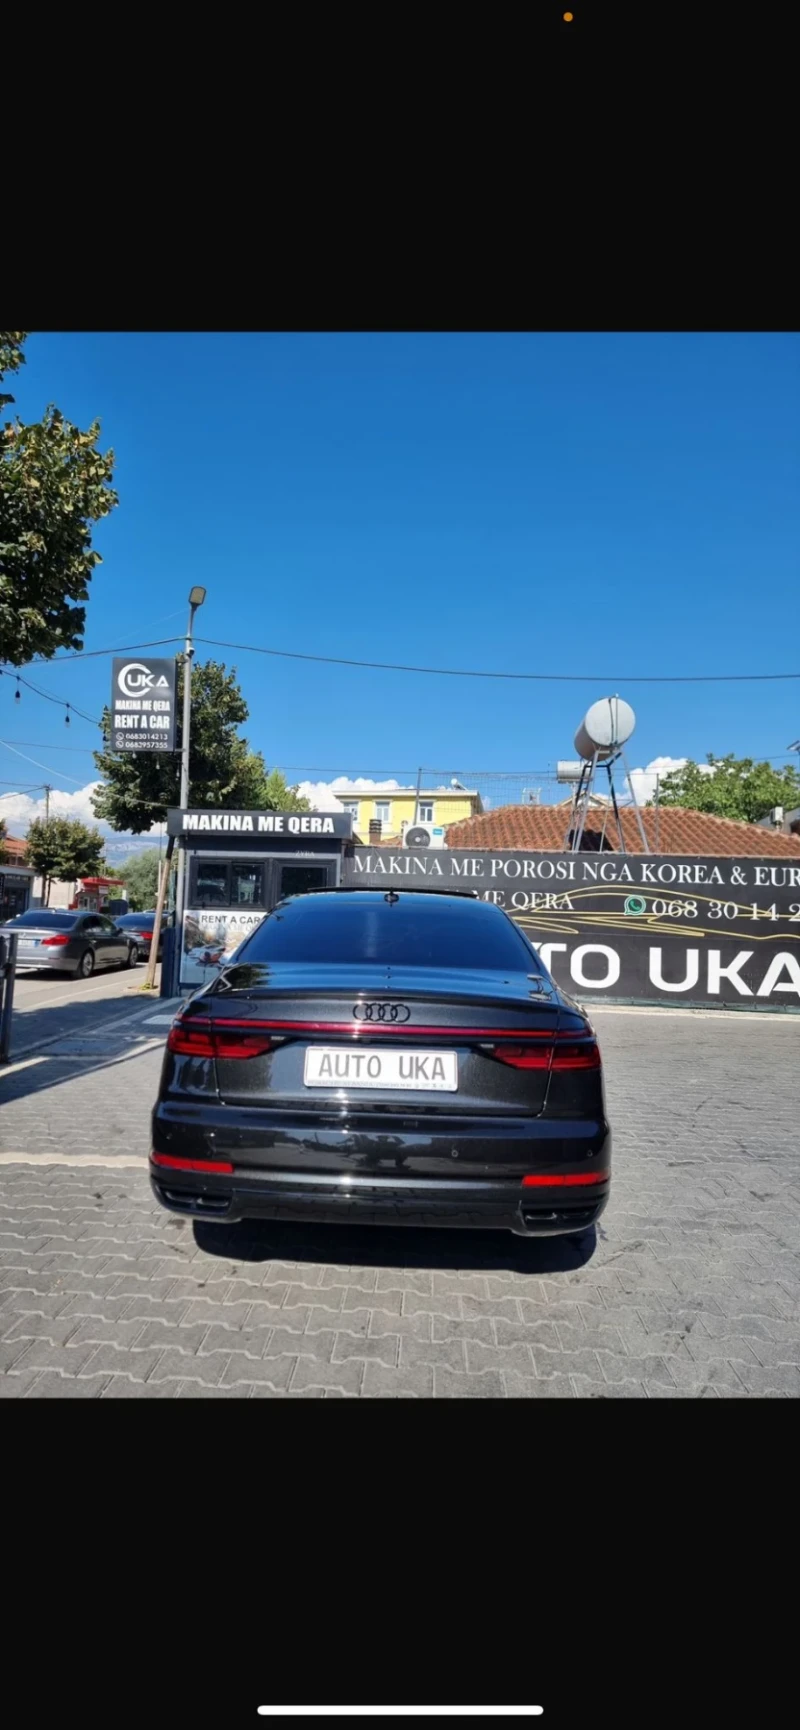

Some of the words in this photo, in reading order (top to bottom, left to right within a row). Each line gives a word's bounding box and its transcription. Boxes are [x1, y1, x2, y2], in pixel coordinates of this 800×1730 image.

[115, 700, 141, 710] MAKINA
[142, 700, 152, 710] ME
[153, 700, 170, 712] QERA
[114, 715, 139, 729] RENT
[141, 715, 148, 729] A
[149, 715, 170, 729] CAR
[182, 814, 254, 831] MAKINA
[258, 816, 284, 832] ME
[287, 816, 335, 834] QERA
[353, 855, 444, 876] MAKINA
[450, 857, 484, 877] ME
[490, 859, 576, 880] POROSI
[582, 862, 635, 882] NGA
[640, 863, 726, 885] KOREA
[730, 866, 748, 886] &
[511, 891, 575, 911] QERA
[652, 900, 698, 918] 068
[707, 902, 738, 919] 30
[750, 902, 780, 921] 14
[201, 915, 228, 923] RENT
[230, 916, 237, 924] A
[239, 916, 261, 924] CAR
[649, 947, 800, 997] UKA
[318, 1053, 382, 1078] AUTO
[399, 1055, 446, 1081] UKA
